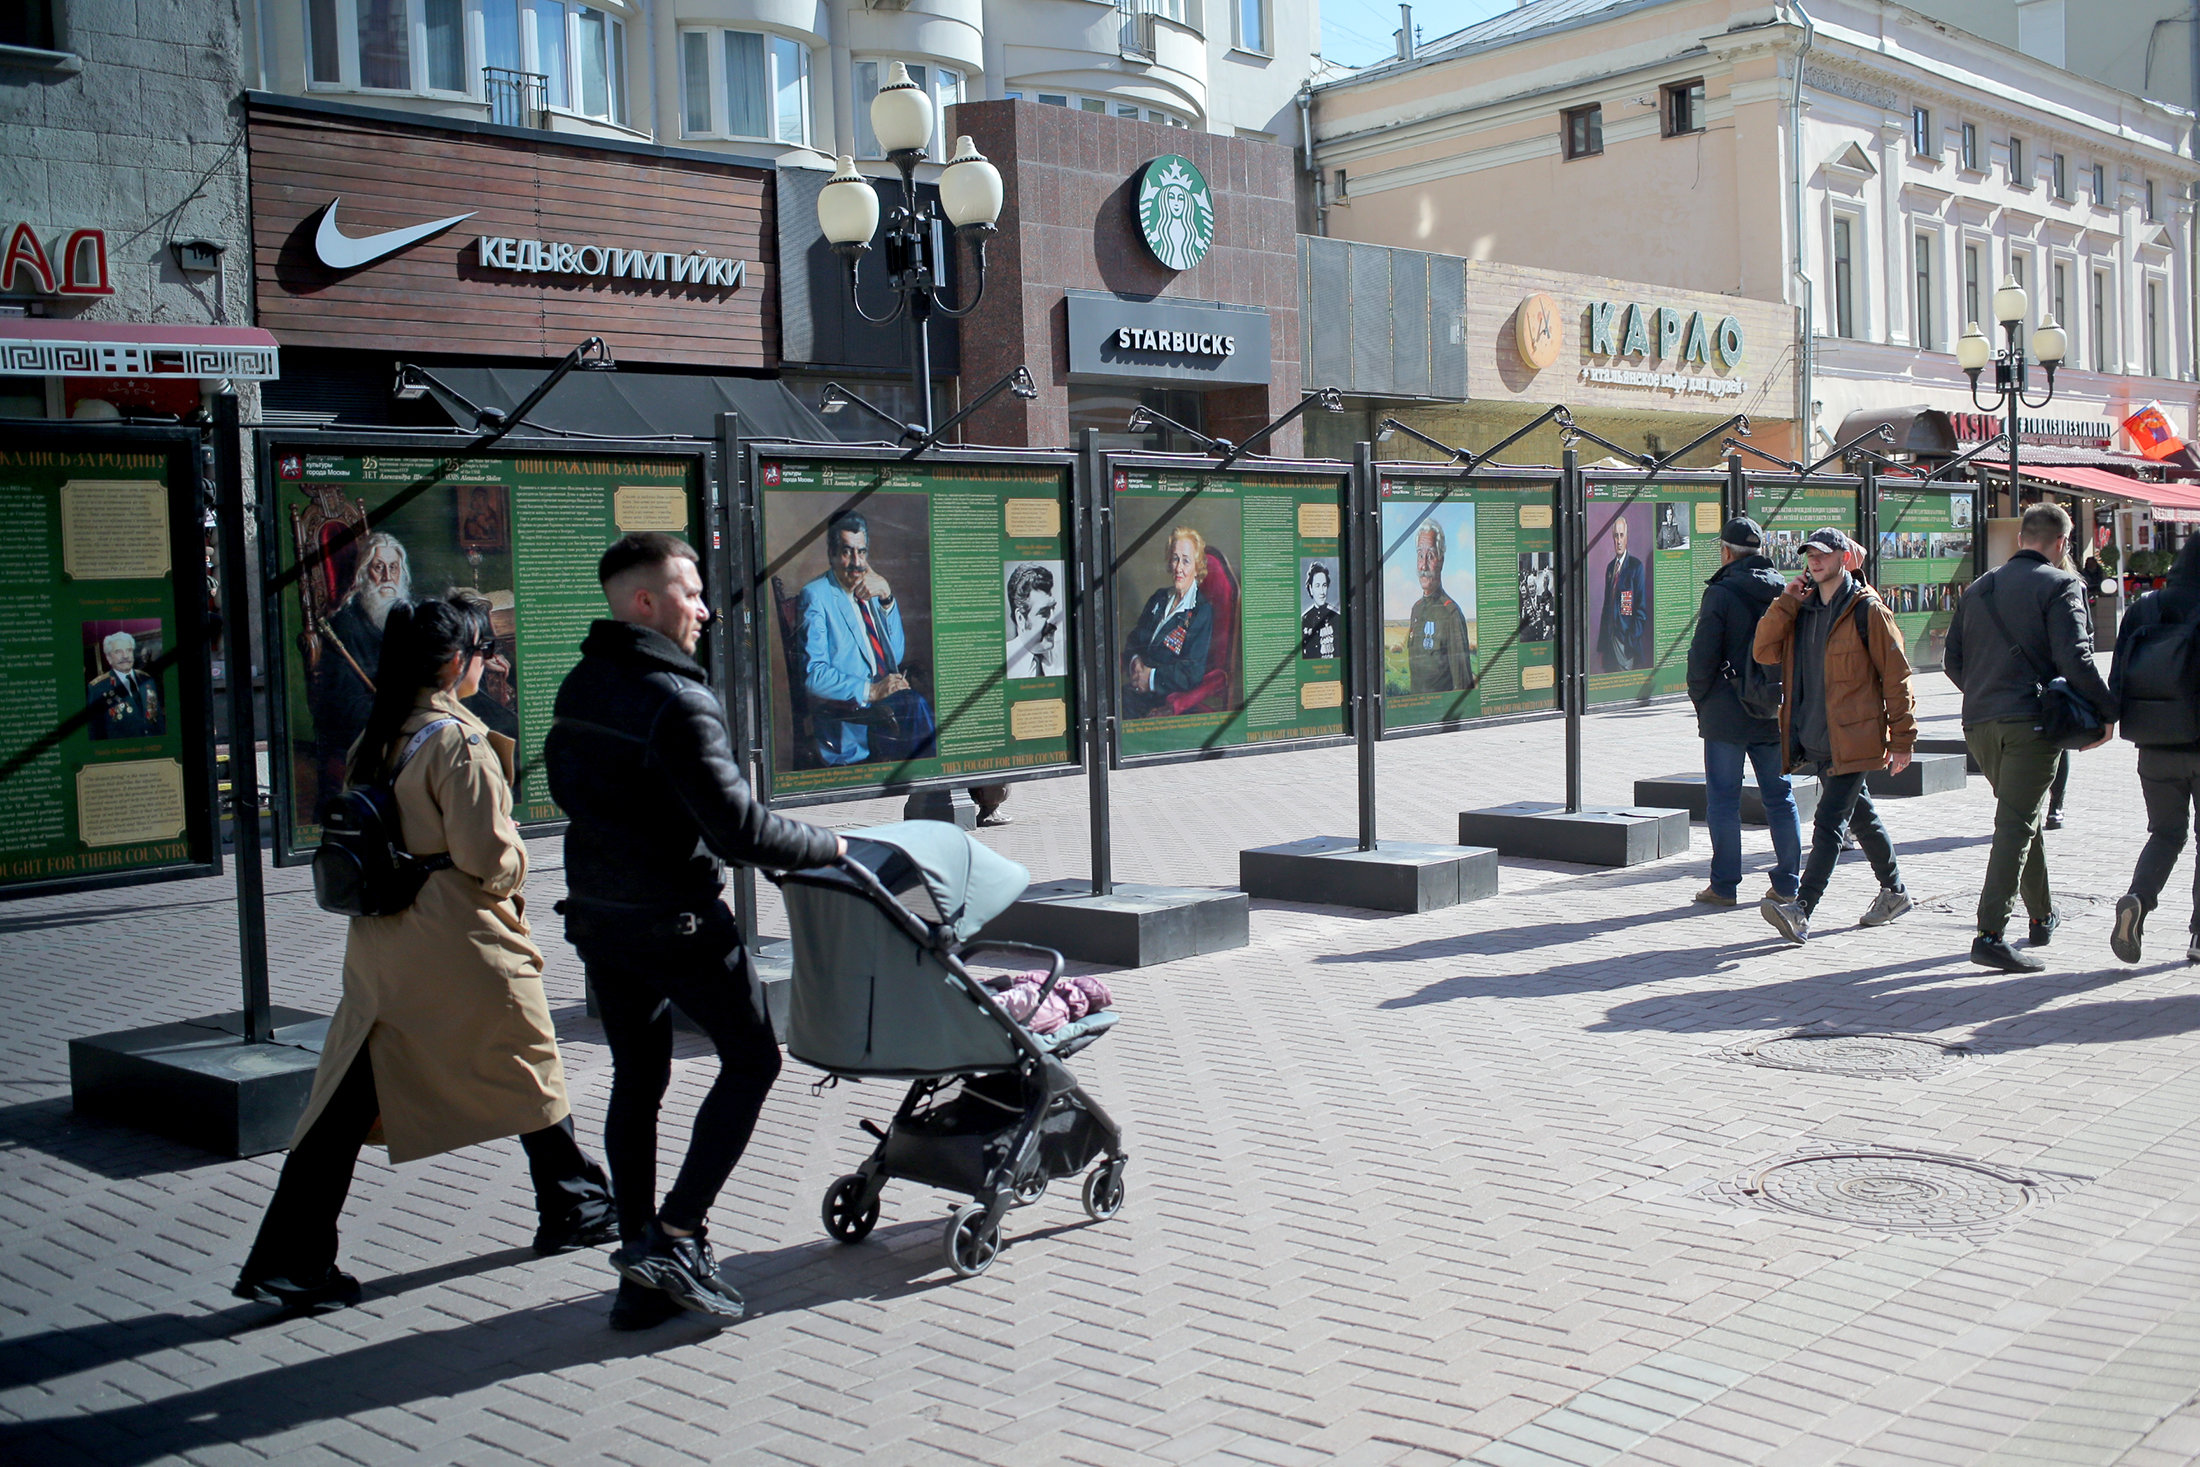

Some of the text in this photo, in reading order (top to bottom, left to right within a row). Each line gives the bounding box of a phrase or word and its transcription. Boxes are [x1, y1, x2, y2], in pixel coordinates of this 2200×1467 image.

[479, 235, 746, 288] КЕДЫ&ОЛИМПИЙКИ
[1119, 326, 1236, 356] STARBUCKS
[1590, 301, 1745, 368] КАРЛО
[1589, 368, 1660, 387] итальянское
[1661, 372, 1687, 393] кафе
[1708, 376, 1742, 397] друзей
[47, 855, 76, 872] FOR
[79, 849, 122, 869] THEIR
